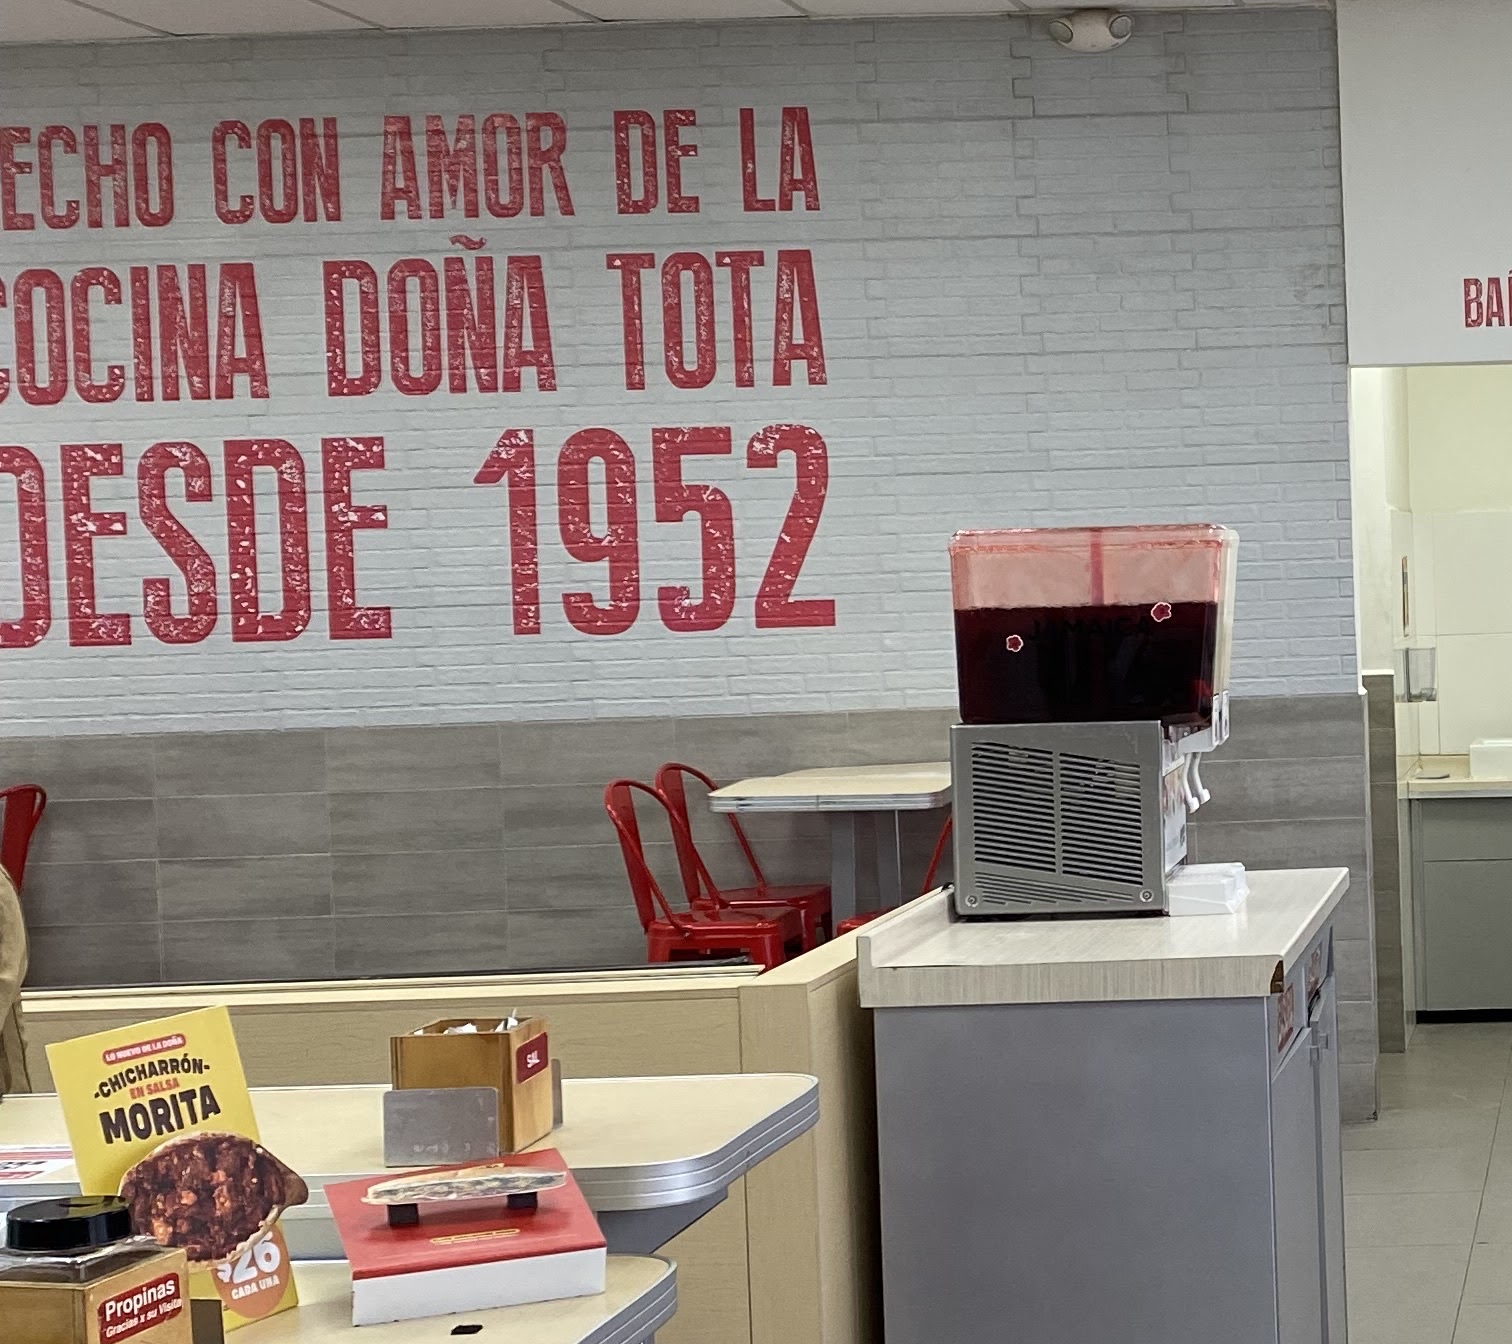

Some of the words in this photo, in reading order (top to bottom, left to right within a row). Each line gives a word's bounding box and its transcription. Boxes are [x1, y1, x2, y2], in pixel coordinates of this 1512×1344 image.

[1, 121, 174, 231] ECHO
[211, 116, 342, 225] CON
[380, 111, 576, 221] AMOR
[612, 108, 701, 215] DE
[738, 105, 821, 213] LA
[322, 233, 558, 398] DOÑA
[605, 248, 828, 392] TOTA
[473, 422, 837, 636] 1952
[98, 1084, 222, 1145] MORITA
[129, 1086, 145, 1100] EN
[146, 1077, 180, 1096] SALSA
[105, 1279, 176, 1322] Propinas
[231, 1281, 259, 1300] CADA
[258, 1274, 280, 1290] UNA
[106, 1316, 139, 1338] Gracias
[146, 1308, 158, 1321] su
